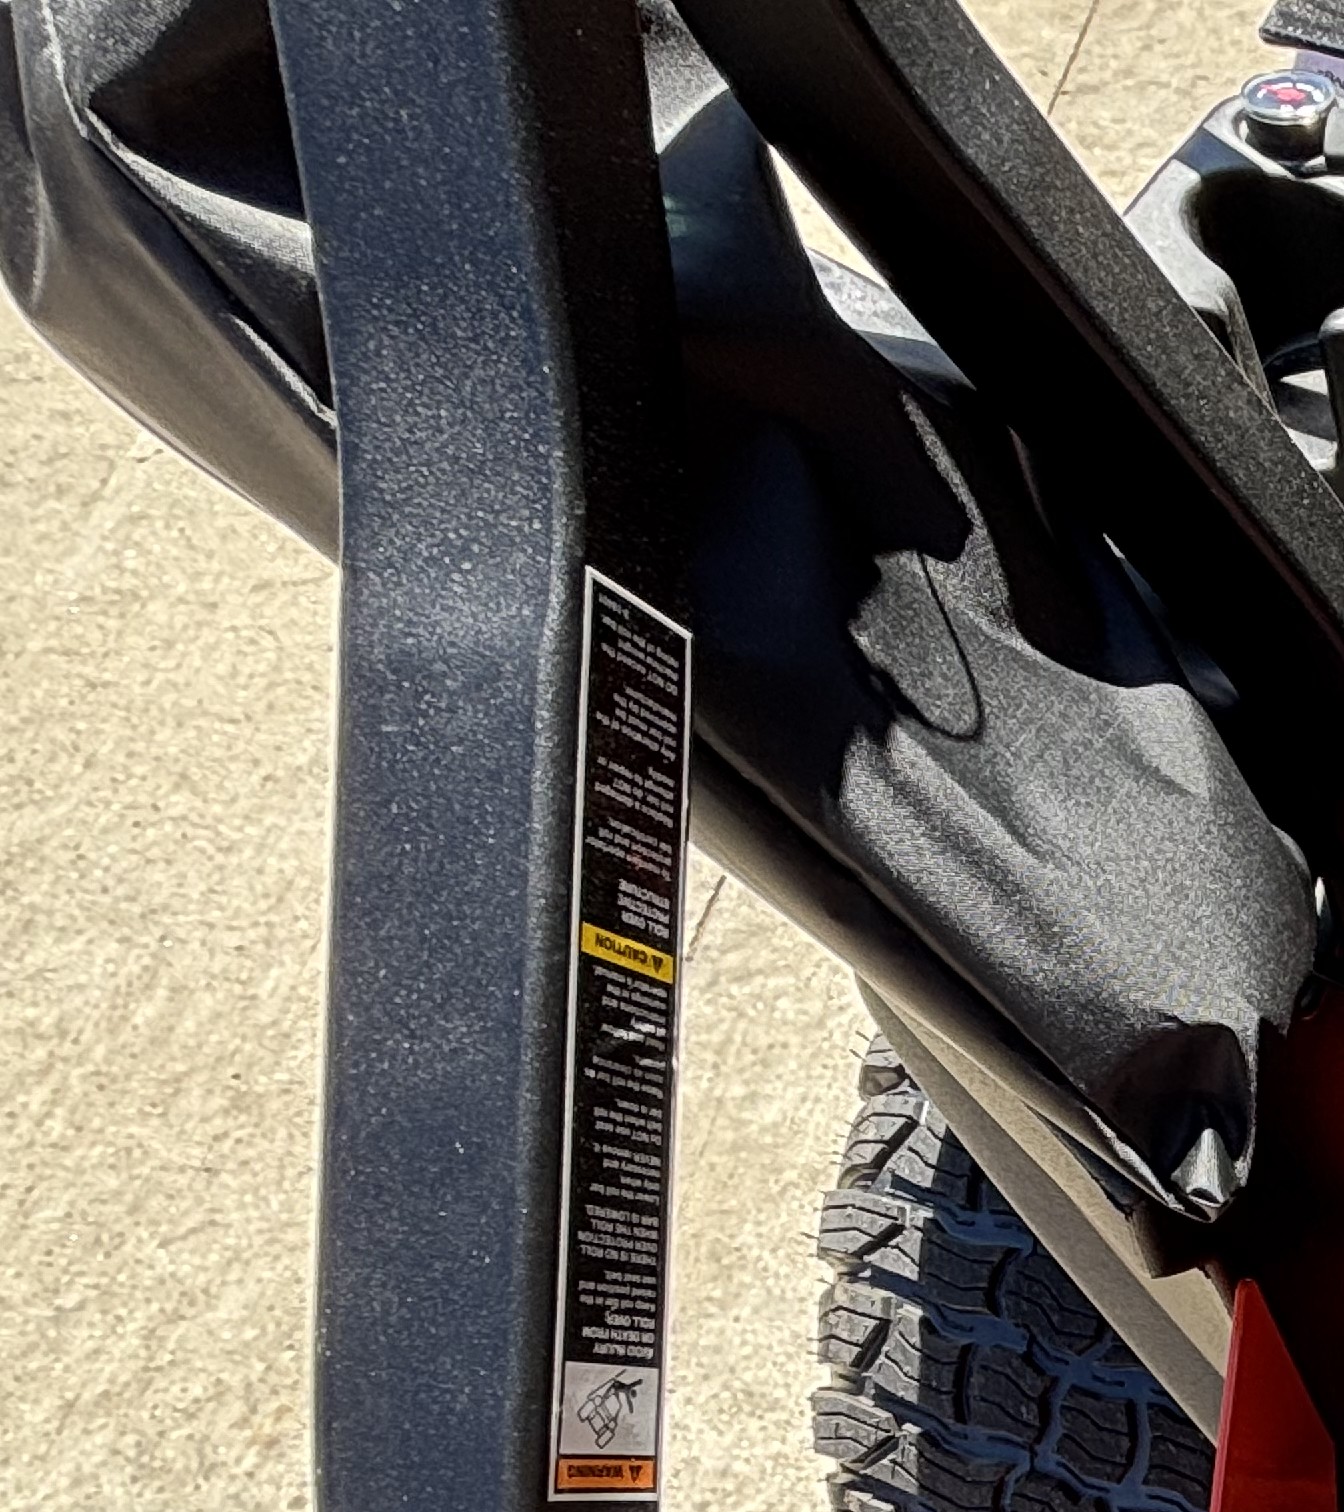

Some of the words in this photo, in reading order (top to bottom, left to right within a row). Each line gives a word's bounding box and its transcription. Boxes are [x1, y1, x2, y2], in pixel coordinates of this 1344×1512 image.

[595, 933, 648, 966] CAUTION
[577, 1231, 634, 1249] PROTECTION
[632, 1316, 655, 1329] ROLL
[582, 1327, 609, 1339] FROM
[610, 1329, 640, 1342] DEATH
[567, 1464, 624, 1479] WARNING
